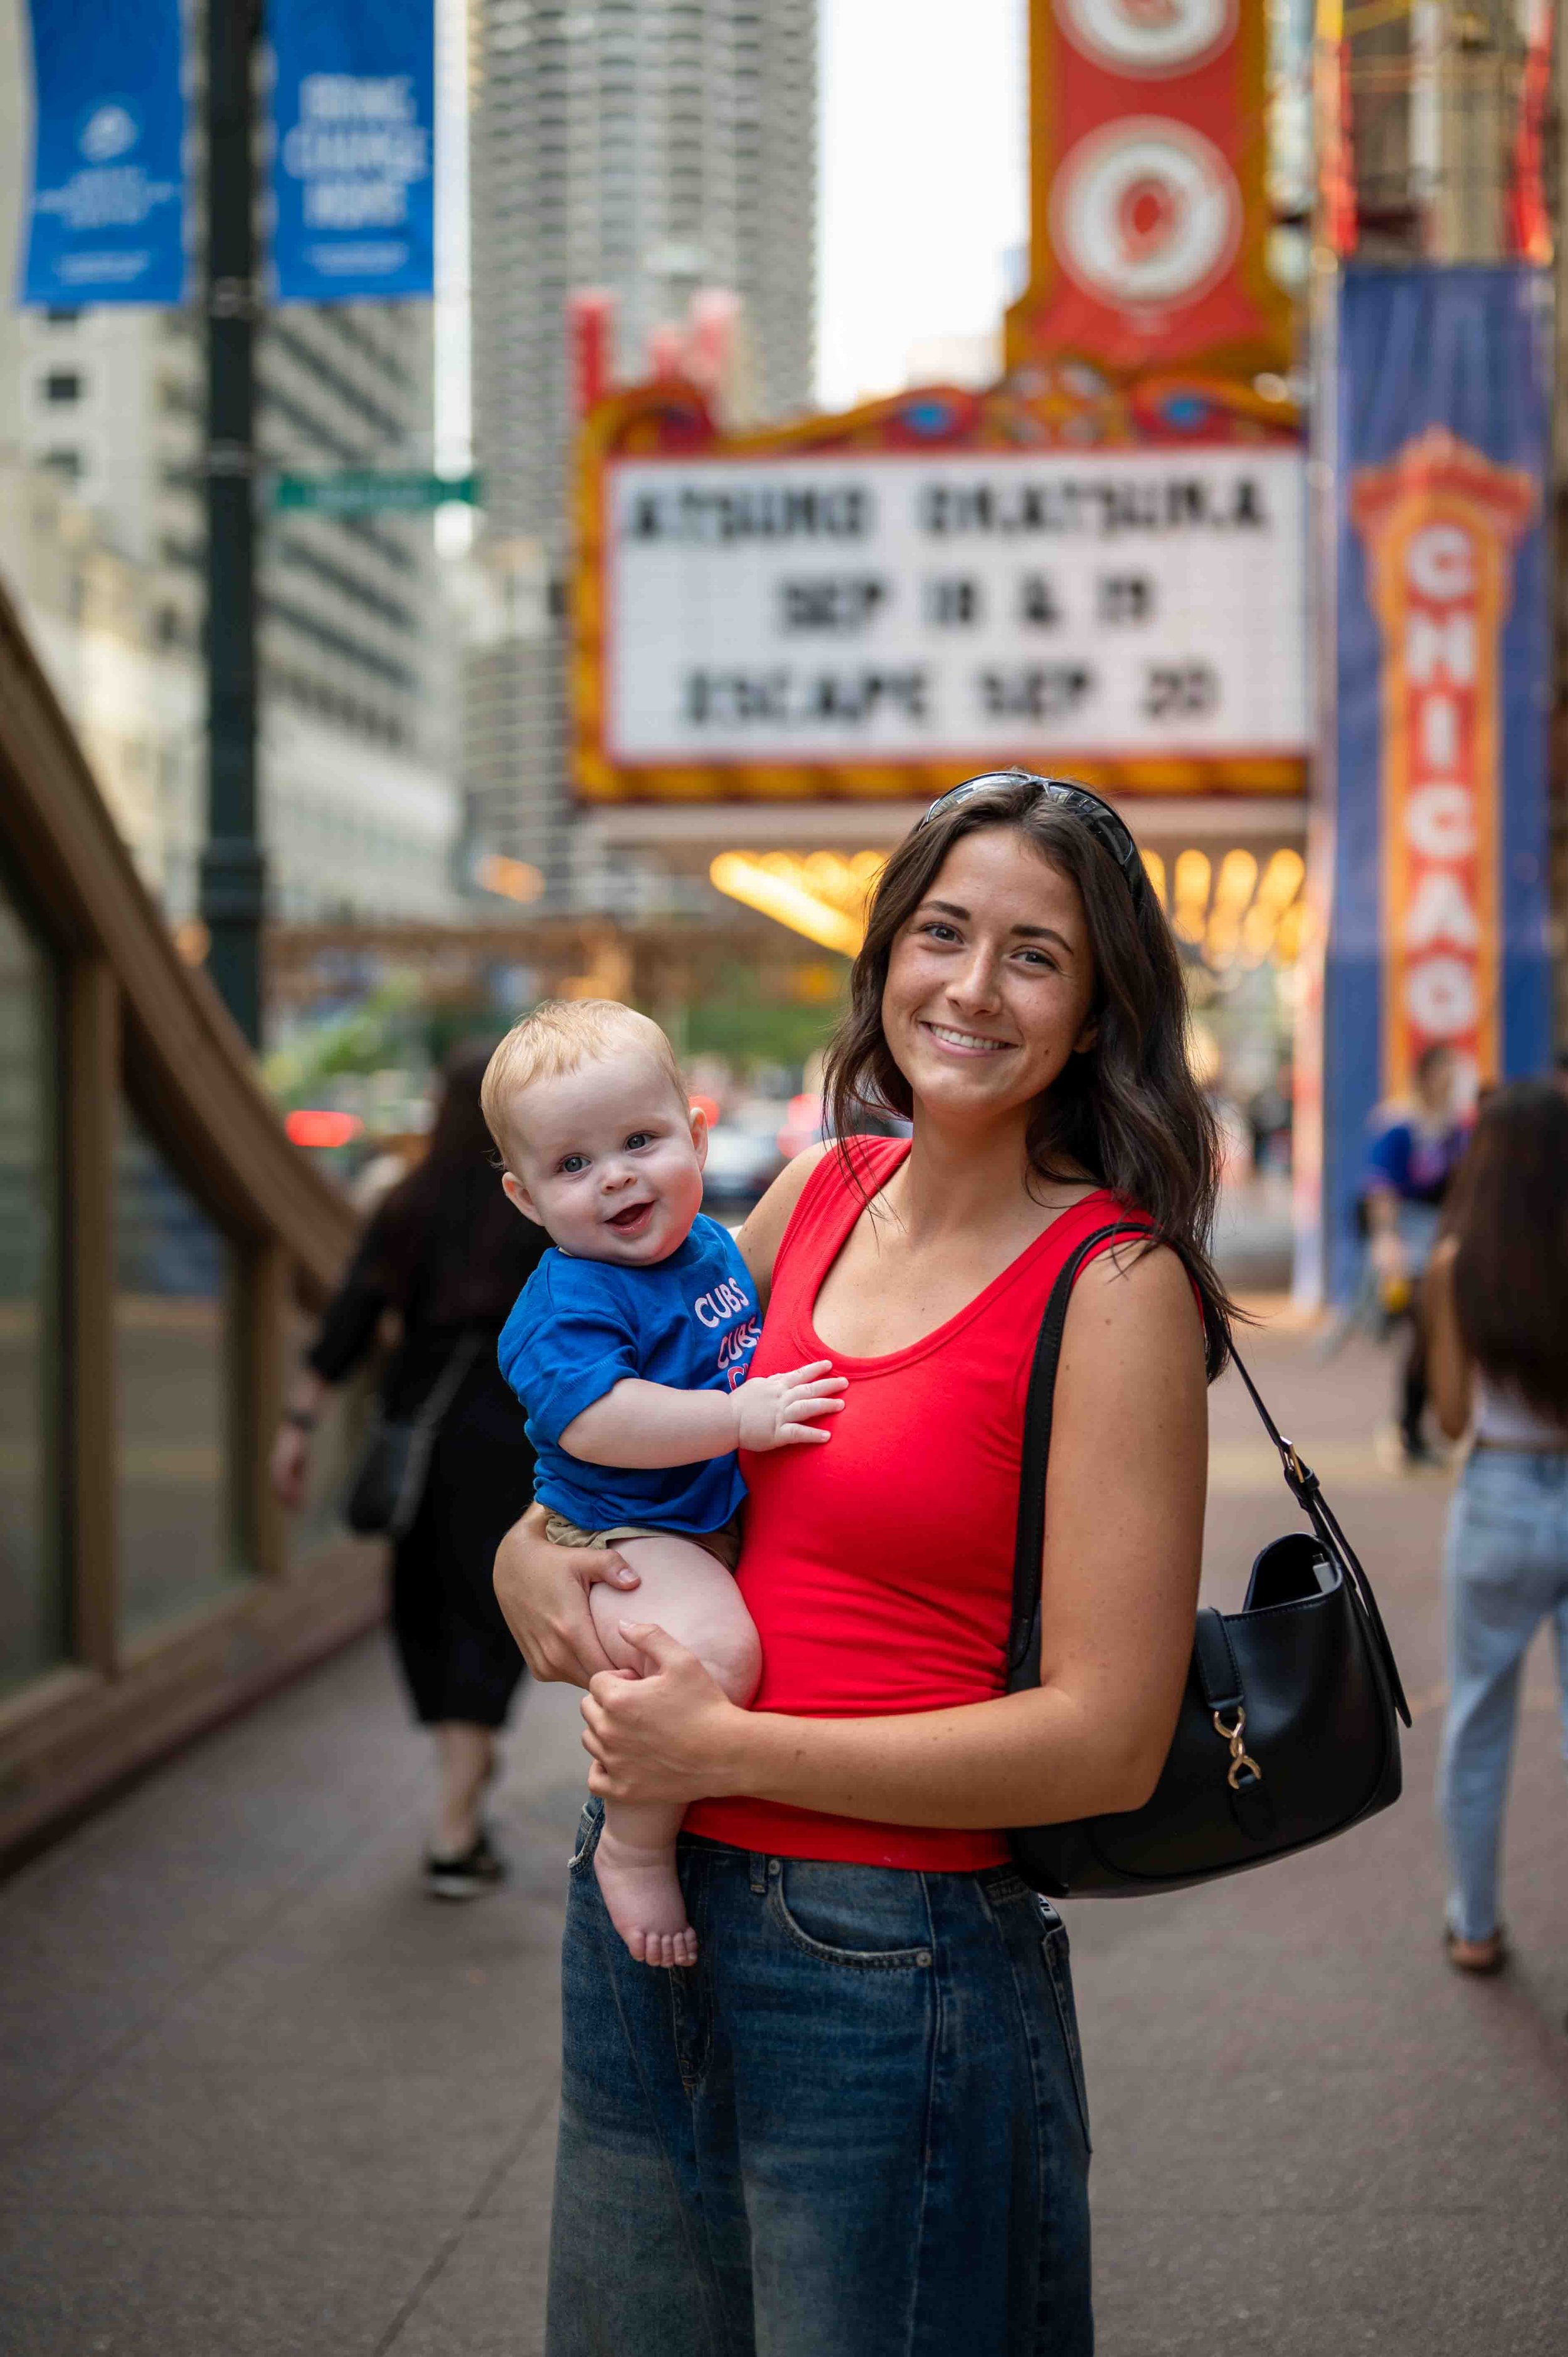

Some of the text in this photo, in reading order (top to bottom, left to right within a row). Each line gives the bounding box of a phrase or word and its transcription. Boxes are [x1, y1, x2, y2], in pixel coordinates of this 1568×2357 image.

[779, 576, 886, 631] SEP
[1021, 571, 1061, 628] &
[687, 661, 1221, 728] ESCAPE SEP 20
[694, 1277, 749, 1328] CUBS
